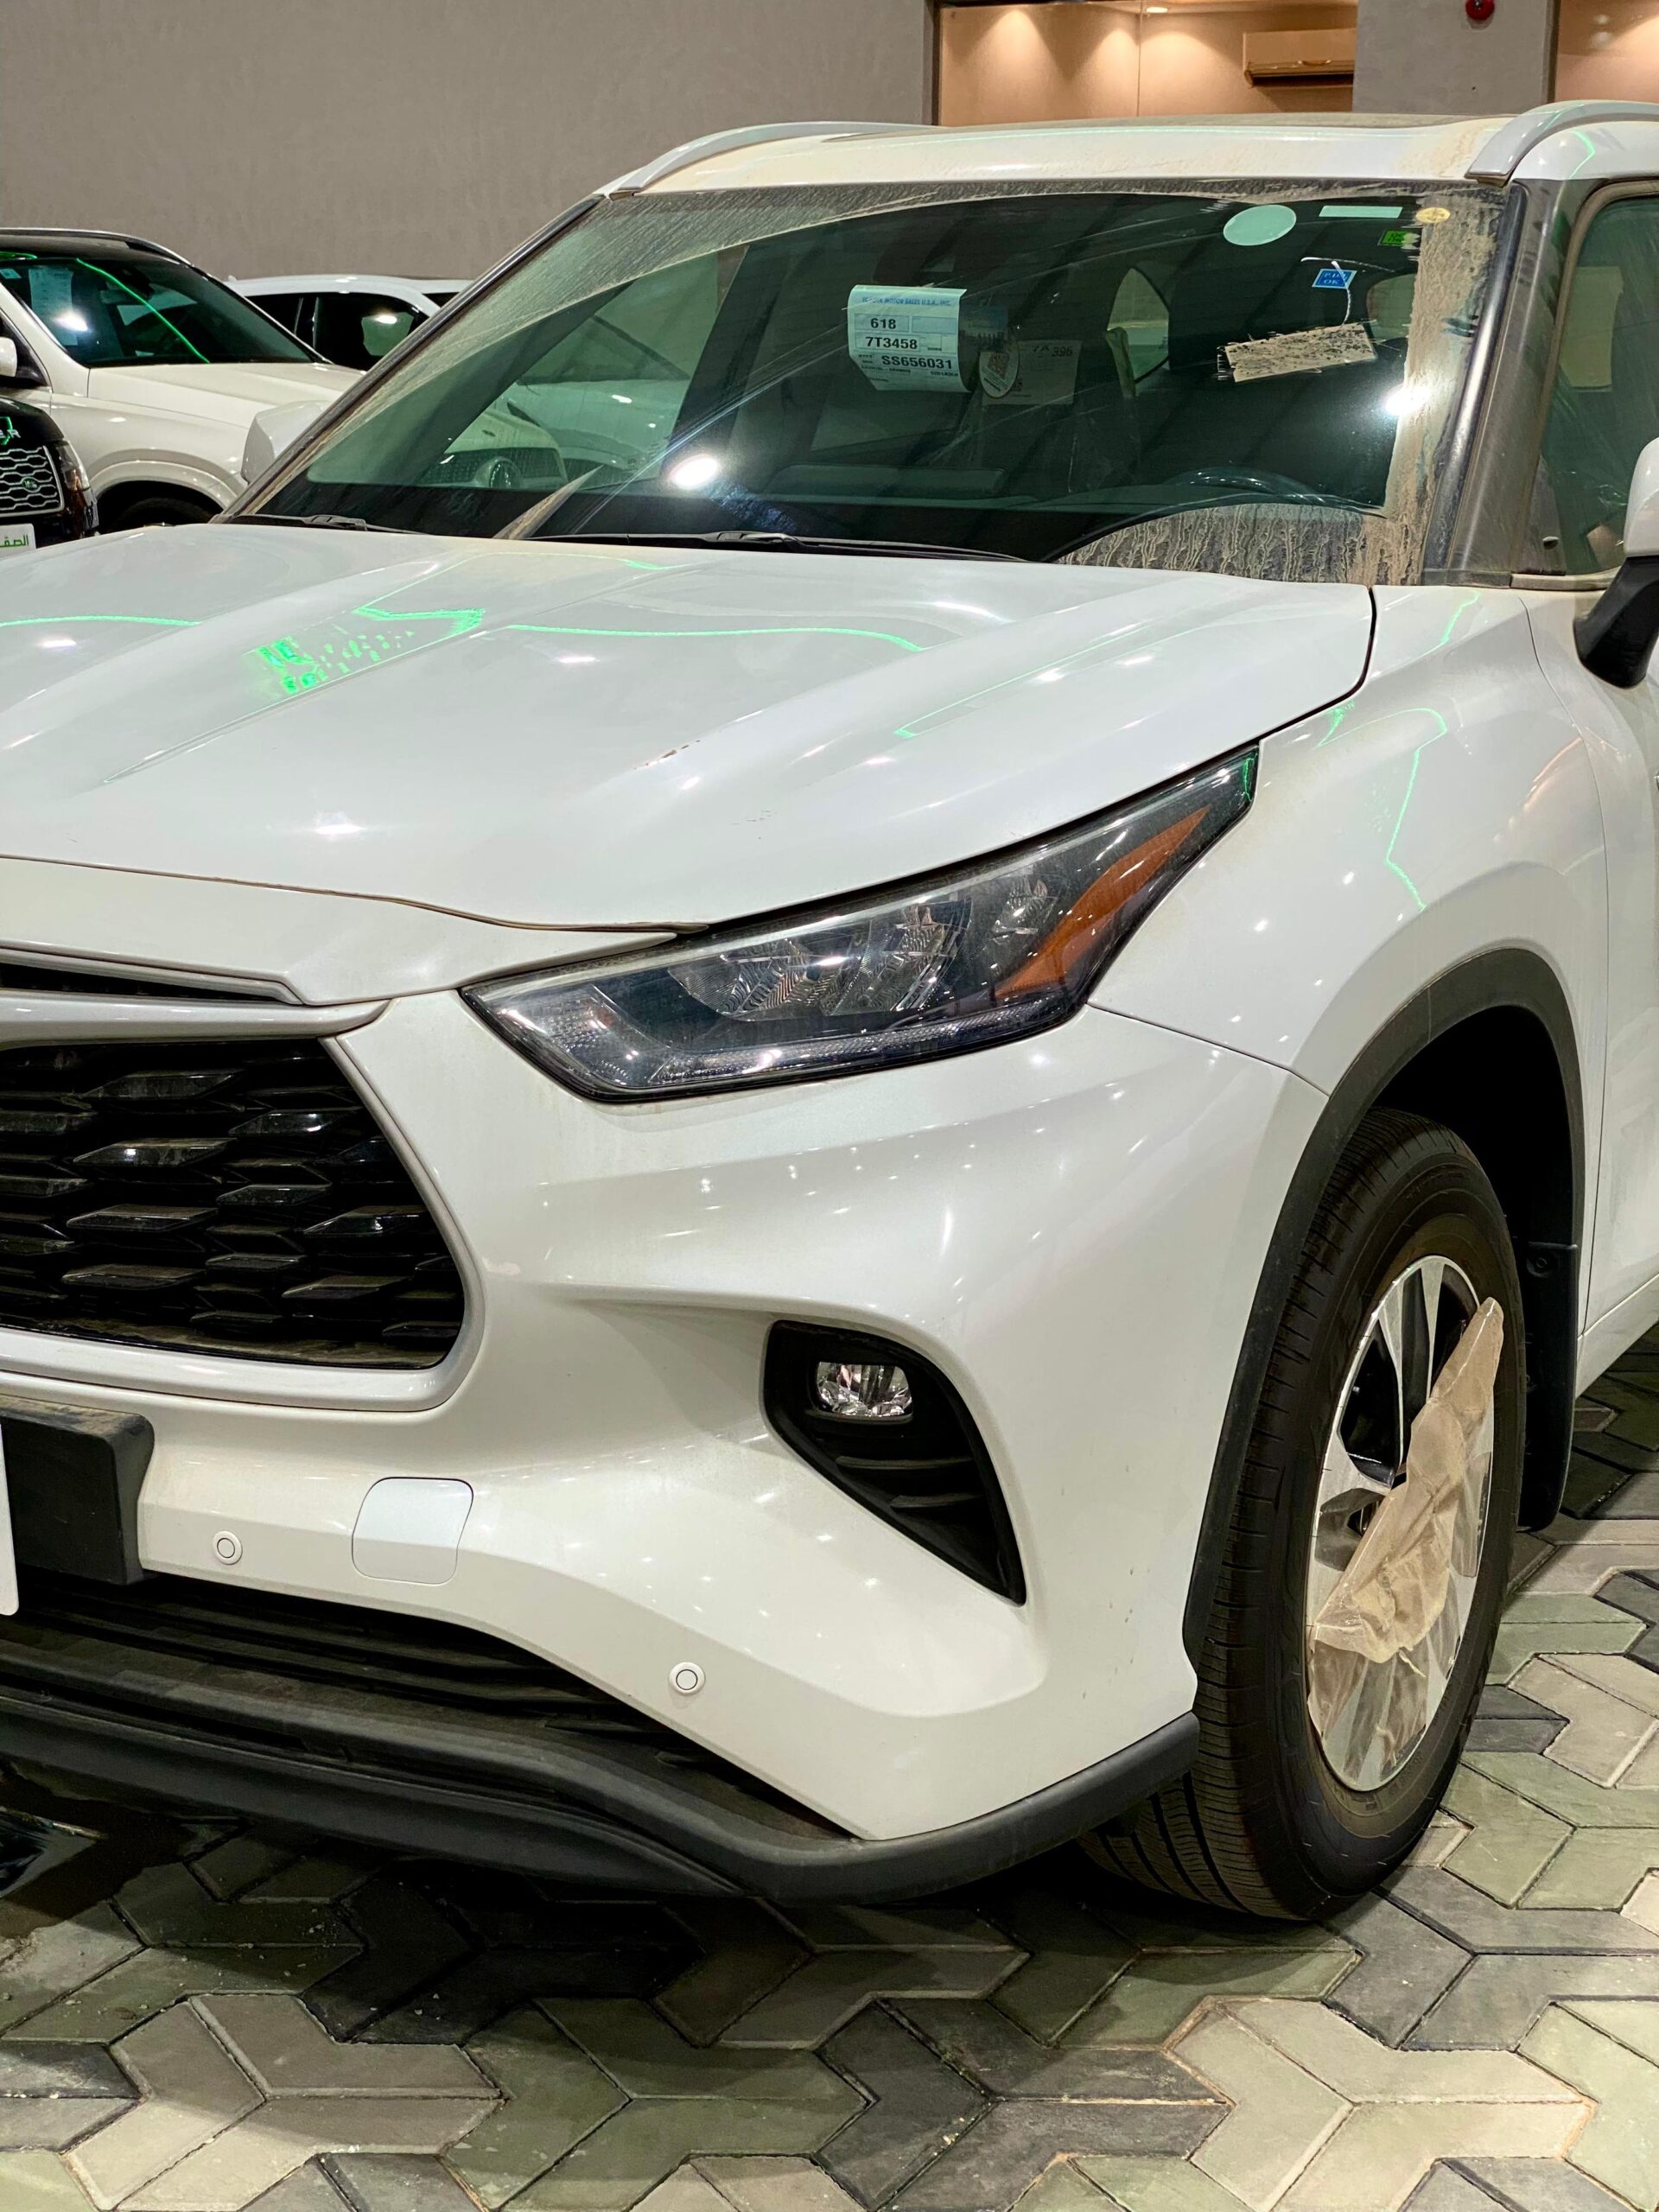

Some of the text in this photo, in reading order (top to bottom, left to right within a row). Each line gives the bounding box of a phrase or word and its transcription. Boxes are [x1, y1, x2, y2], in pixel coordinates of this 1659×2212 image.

[870, 317, 896, 329] 618
[865, 336, 918, 350] 7T3458
[881, 355, 952, 369] SS656031
